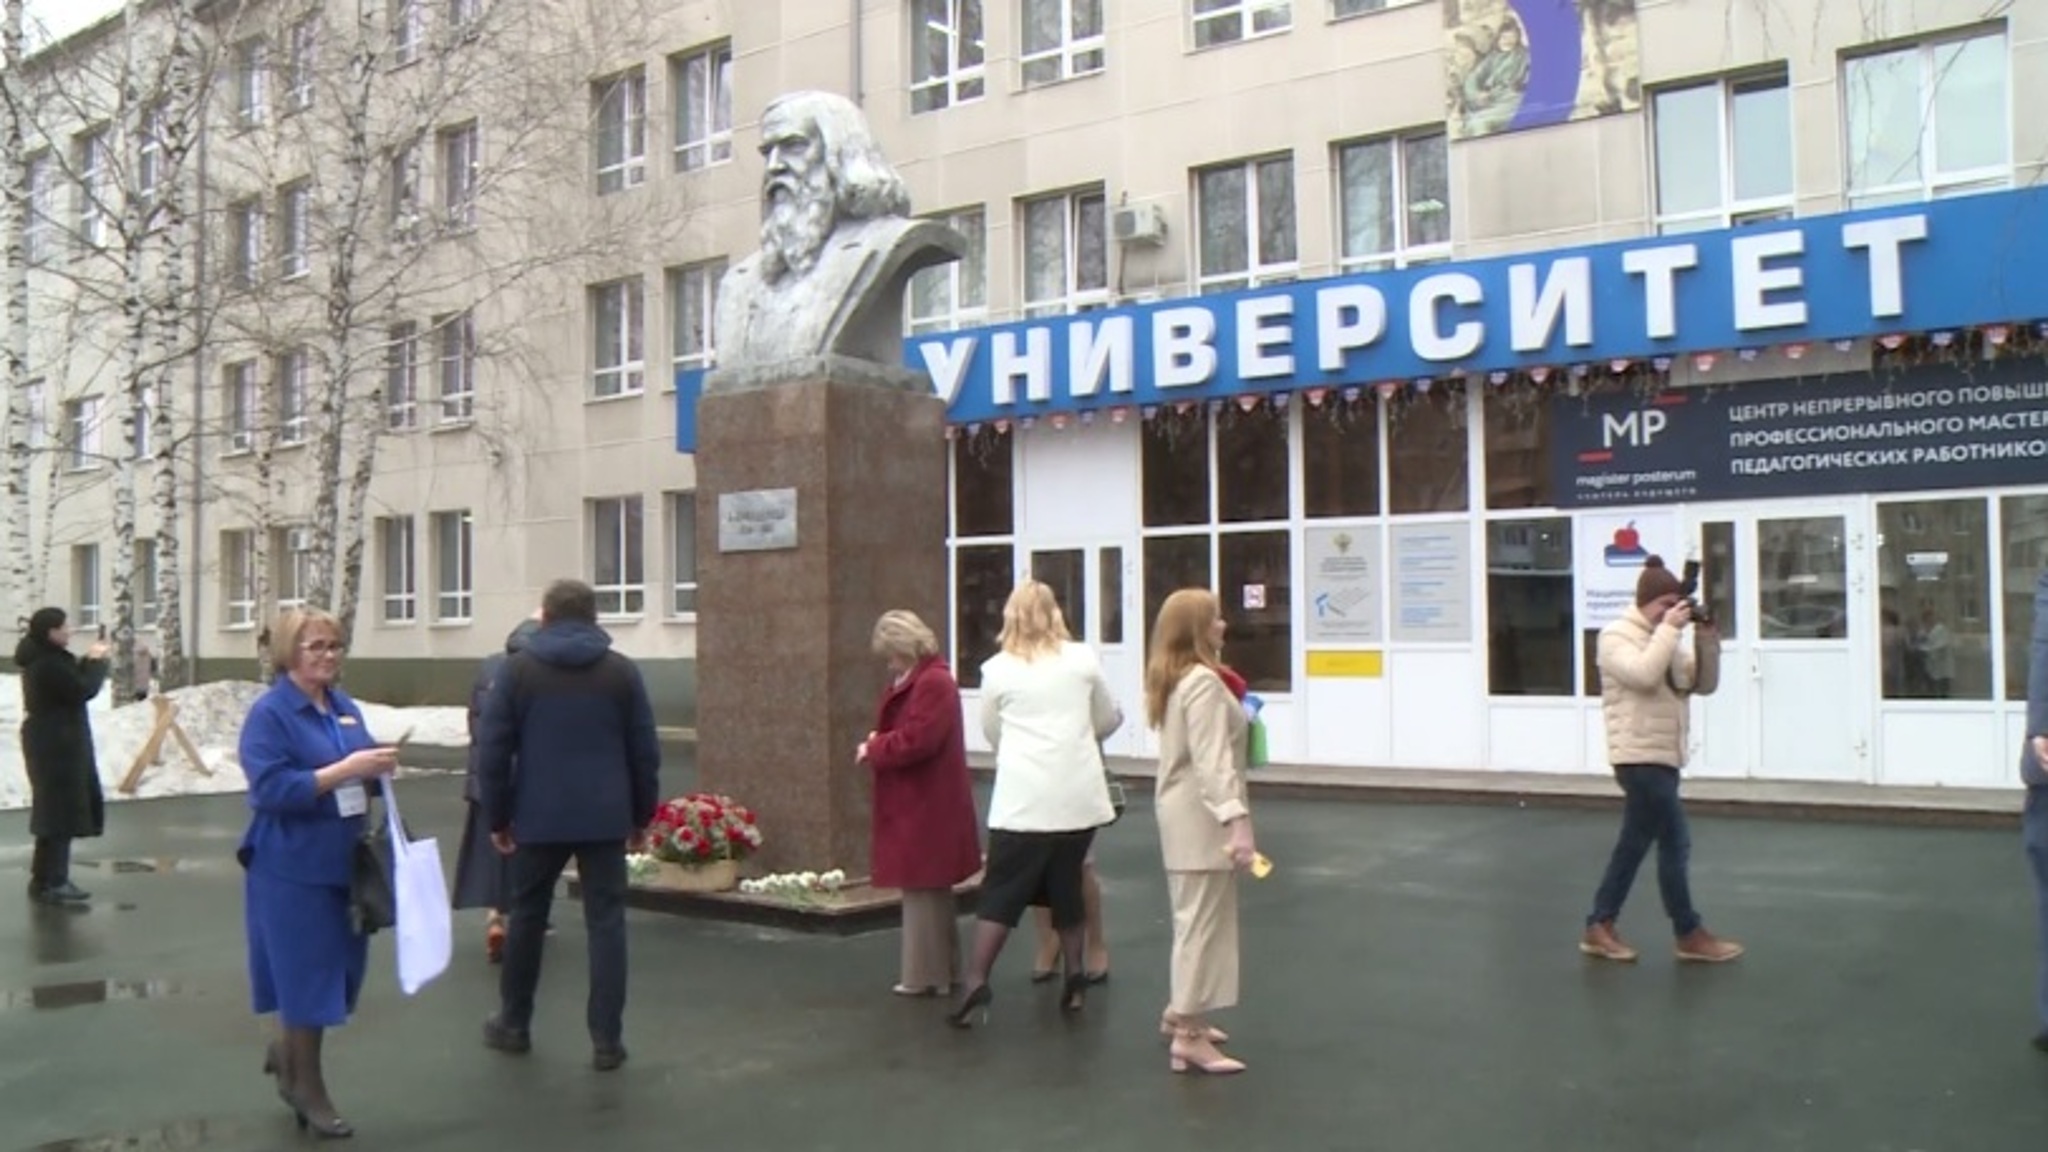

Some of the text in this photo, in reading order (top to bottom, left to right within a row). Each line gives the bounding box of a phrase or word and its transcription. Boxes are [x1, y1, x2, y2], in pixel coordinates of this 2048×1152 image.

[918, 213, 1929, 406] УНИВЕРСИТЕТ
[1729, 402, 1789, 423] ЦЕНТР
[1792, 389, 1954, 417] НЕПРЕРЫВНОГО
[1602, 408, 1668, 449] MP
[1729, 416, 1964, 448] ПРОФЕССИОНАЛЬНОГО
[1731, 439, 2048, 475] ПЕДАГОГИЧЕСКИХ РАБОТНИКО
[1632, 470, 1697, 486] posterum
